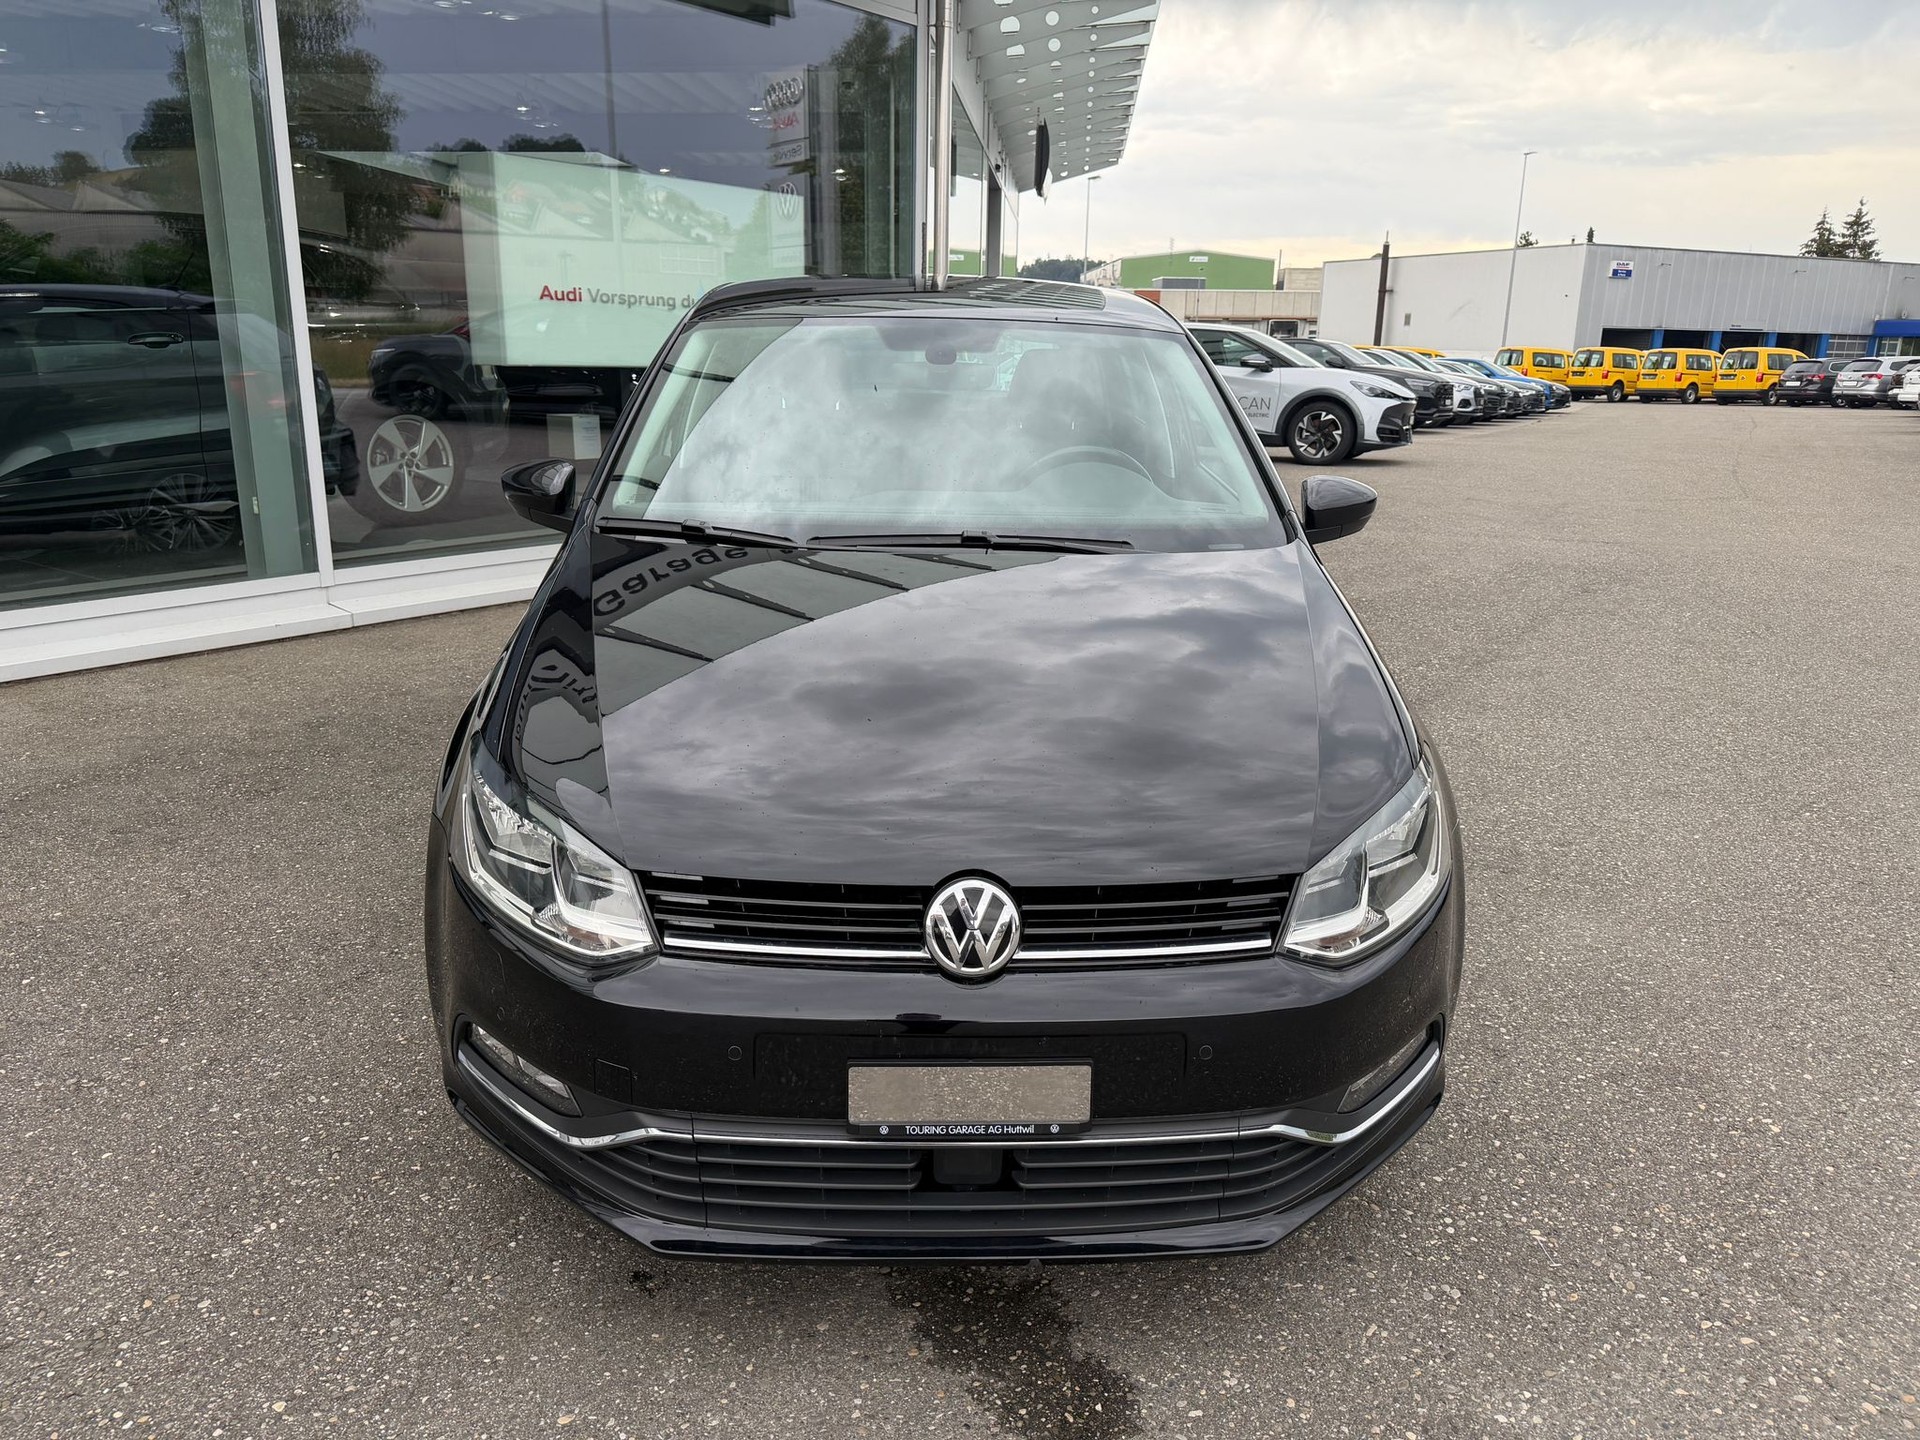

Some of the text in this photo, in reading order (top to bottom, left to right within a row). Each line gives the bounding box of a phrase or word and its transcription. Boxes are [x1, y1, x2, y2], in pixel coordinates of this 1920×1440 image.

[539, 285, 583, 302] Audi
[587, 288, 677, 311] Vorsprung
[905, 1125, 946, 1135] TOURING
[948, 1125, 986, 1135] GARAGE
[987, 1125, 1002, 1134] AG
[1003, 1124, 1035, 1134] Huttwil
